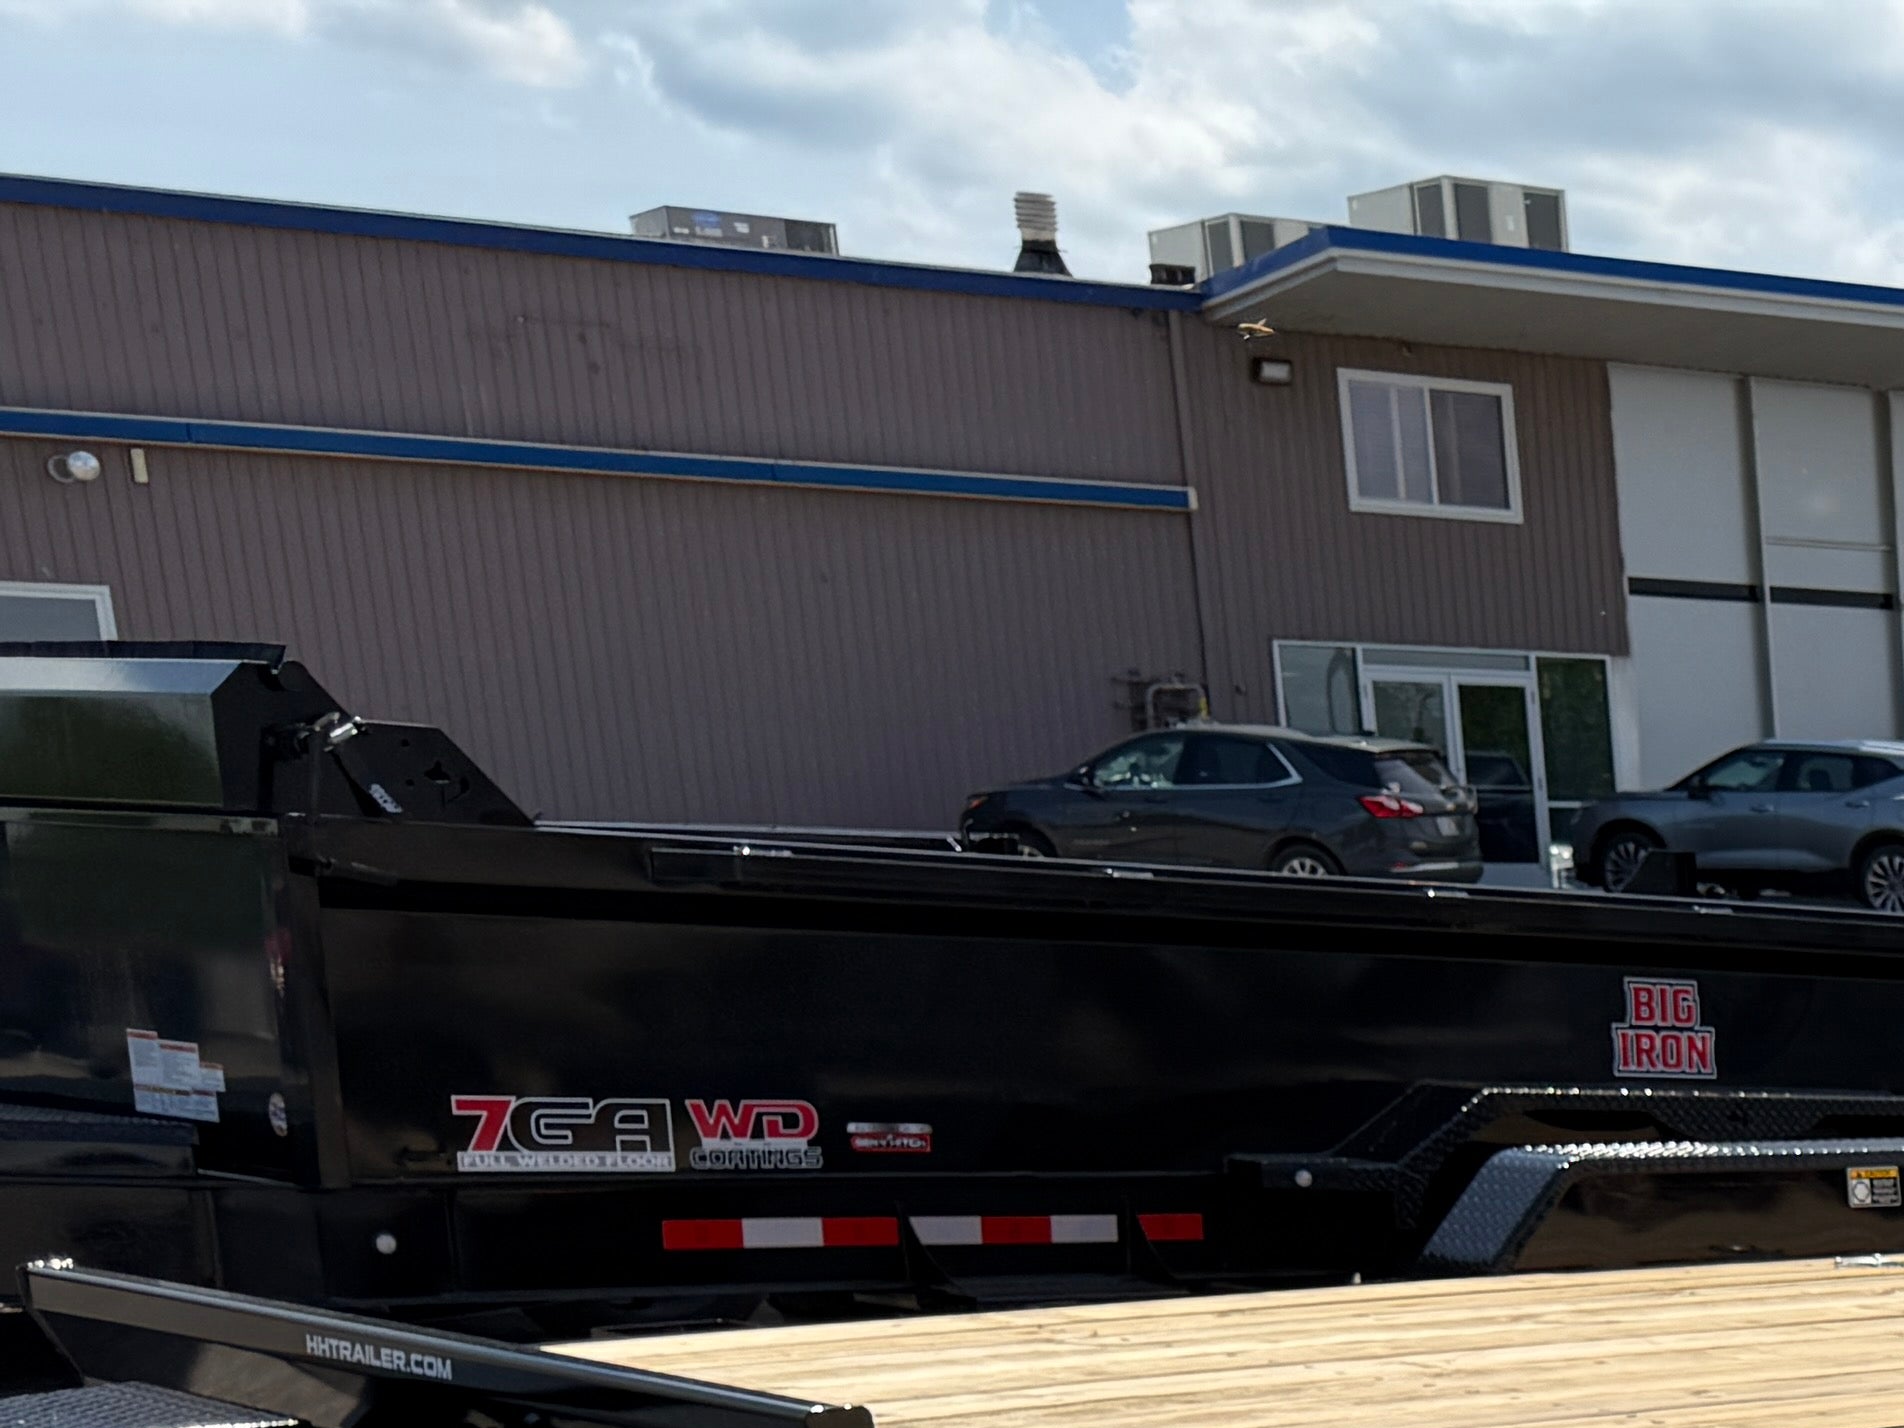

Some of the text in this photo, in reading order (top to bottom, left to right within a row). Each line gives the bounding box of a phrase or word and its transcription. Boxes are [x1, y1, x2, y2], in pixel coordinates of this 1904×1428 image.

[1629, 983, 1696, 1027] BIG
[1617, 1029, 1713, 1073] IRON
[450, 1094, 673, 1153] 7GA
[685, 1098, 819, 1140] WD
[461, 1153, 671, 1168] FULL WELDED FLOOR
[689, 1146, 823, 1170] COATINGS
[305, 1334, 453, 1381] HHTRAILER.COM
